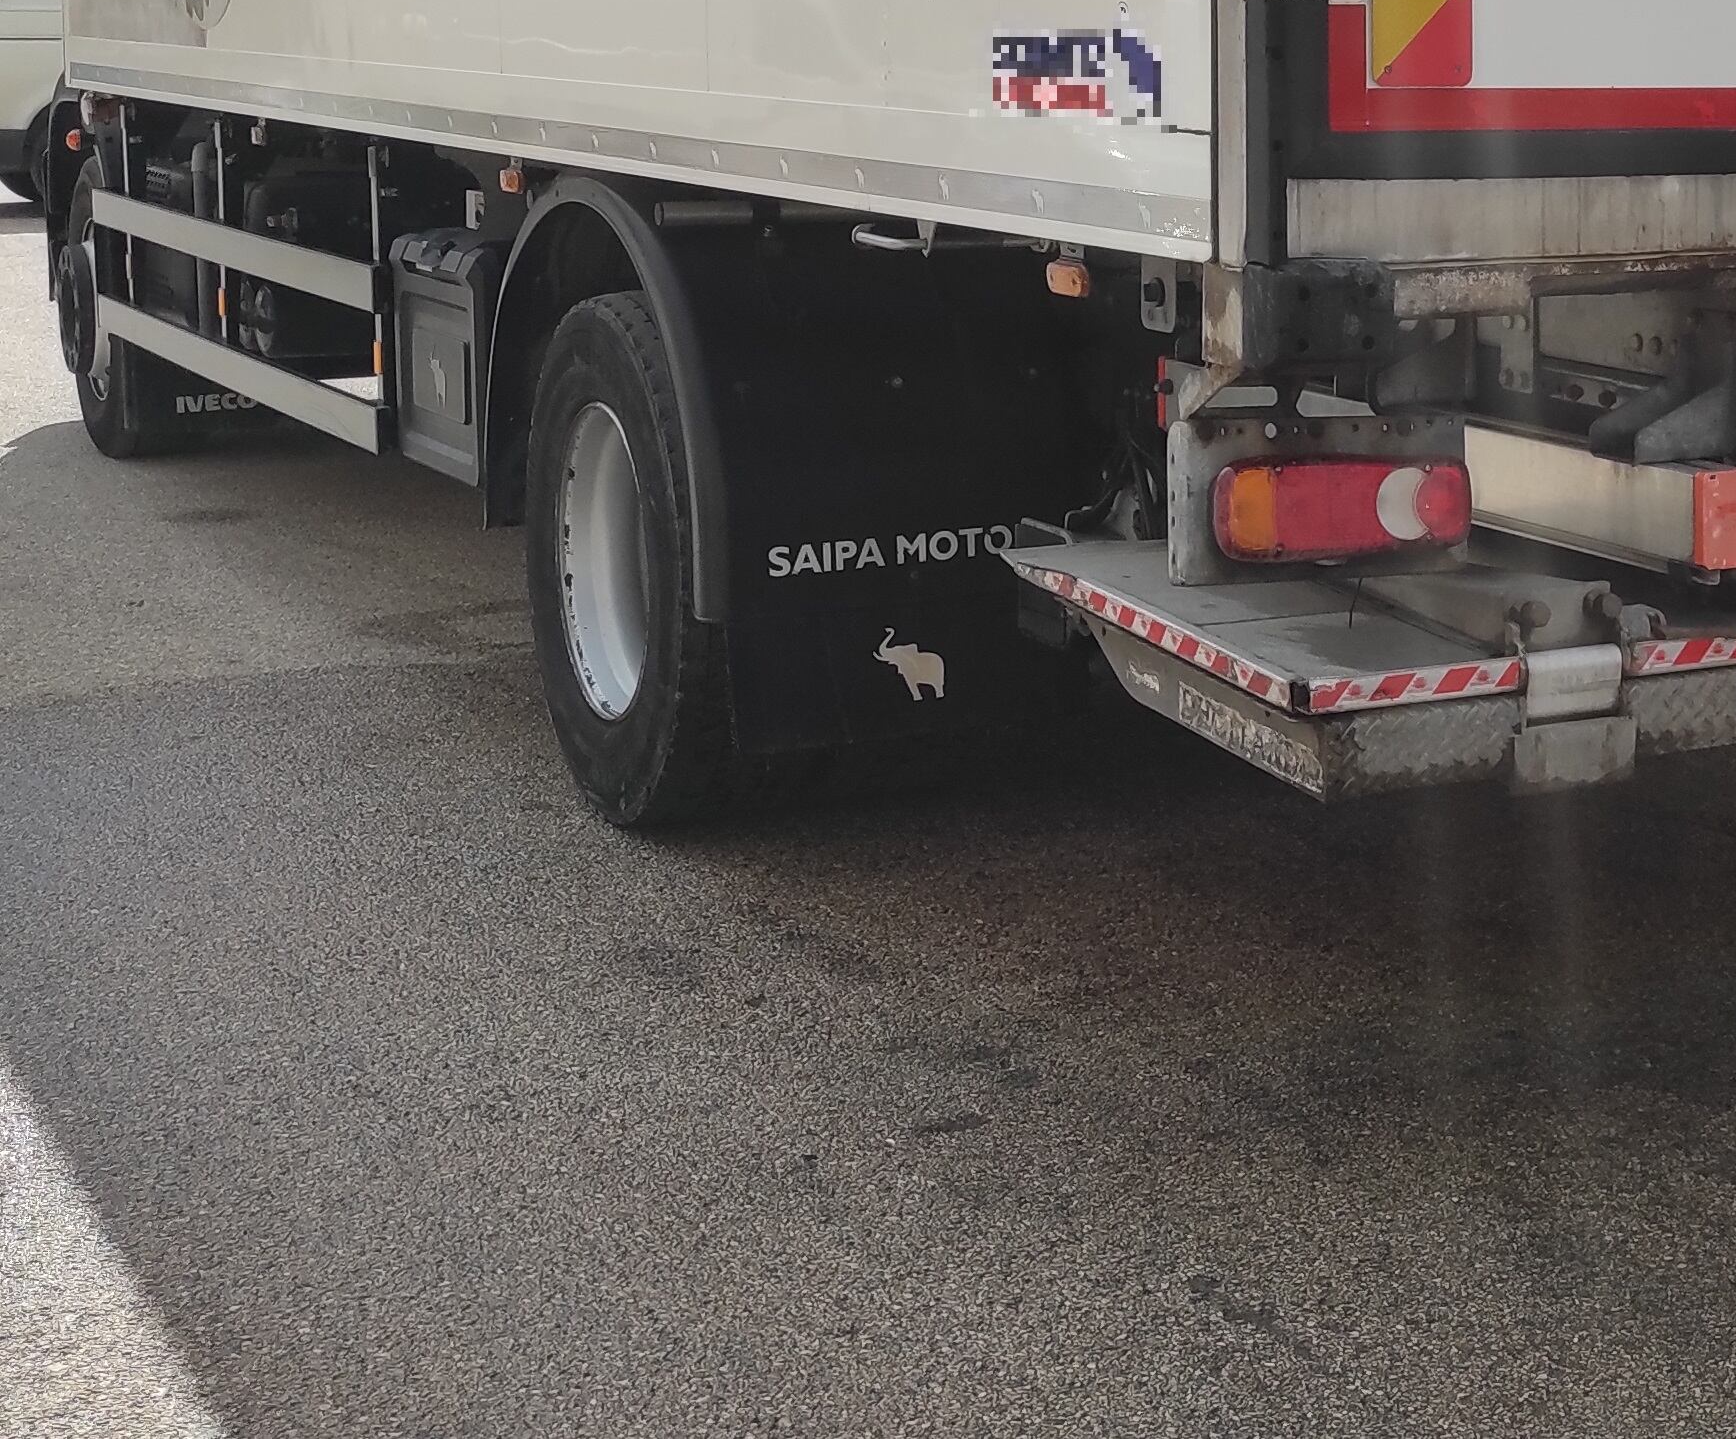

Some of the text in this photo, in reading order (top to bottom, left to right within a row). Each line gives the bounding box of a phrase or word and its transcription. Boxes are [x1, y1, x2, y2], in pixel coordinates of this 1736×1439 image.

[176, 392, 257, 414] IVECO
[767, 524, 1013, 578] SAIPA MOTO
